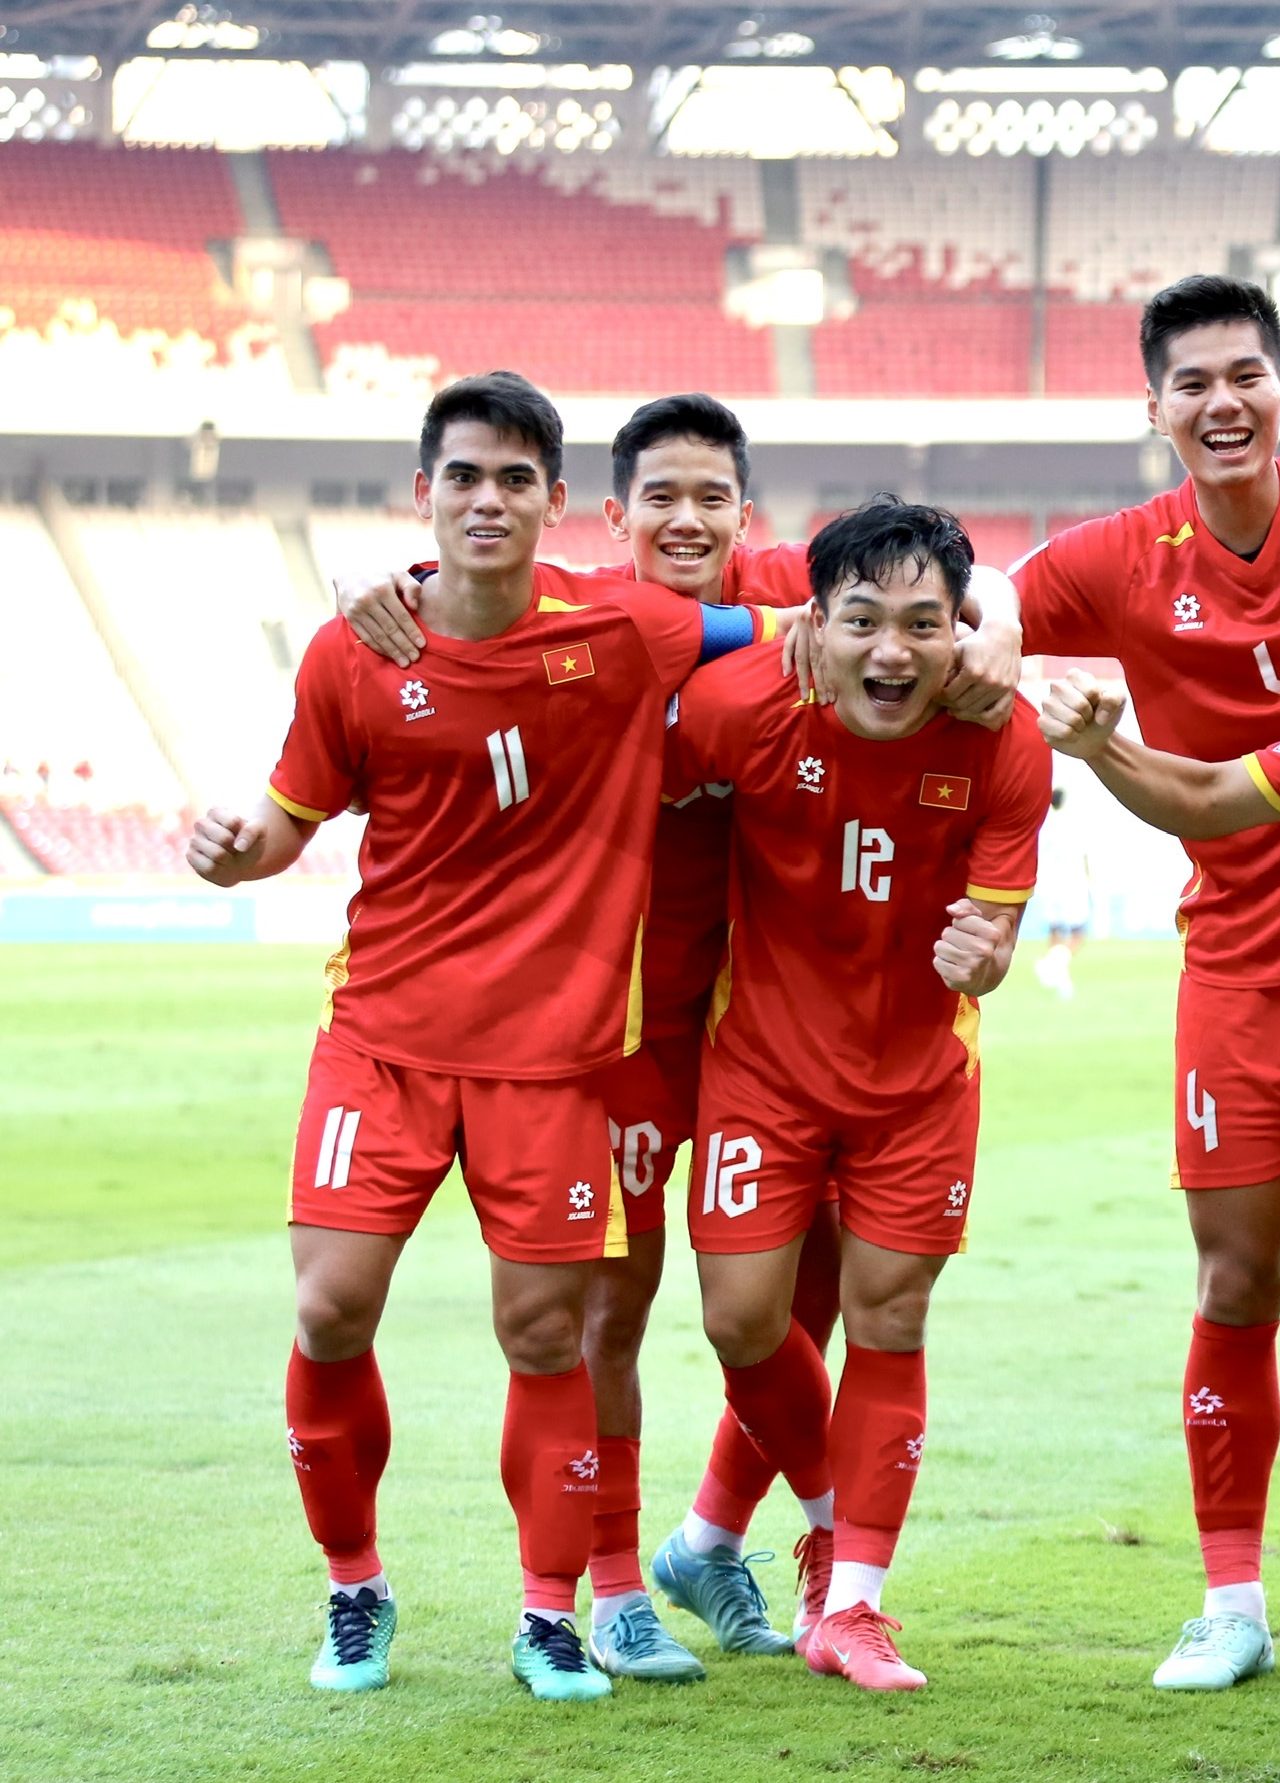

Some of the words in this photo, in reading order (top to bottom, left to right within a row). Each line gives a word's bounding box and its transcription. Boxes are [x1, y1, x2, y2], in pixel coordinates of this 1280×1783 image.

[485, 725, 530, 812] 11
[841, 819, 895, 902] 12
[314, 1105, 362, 1190] 11
[1186, 1067, 1219, 1153] 4
[702, 1131, 762, 1219] 12
